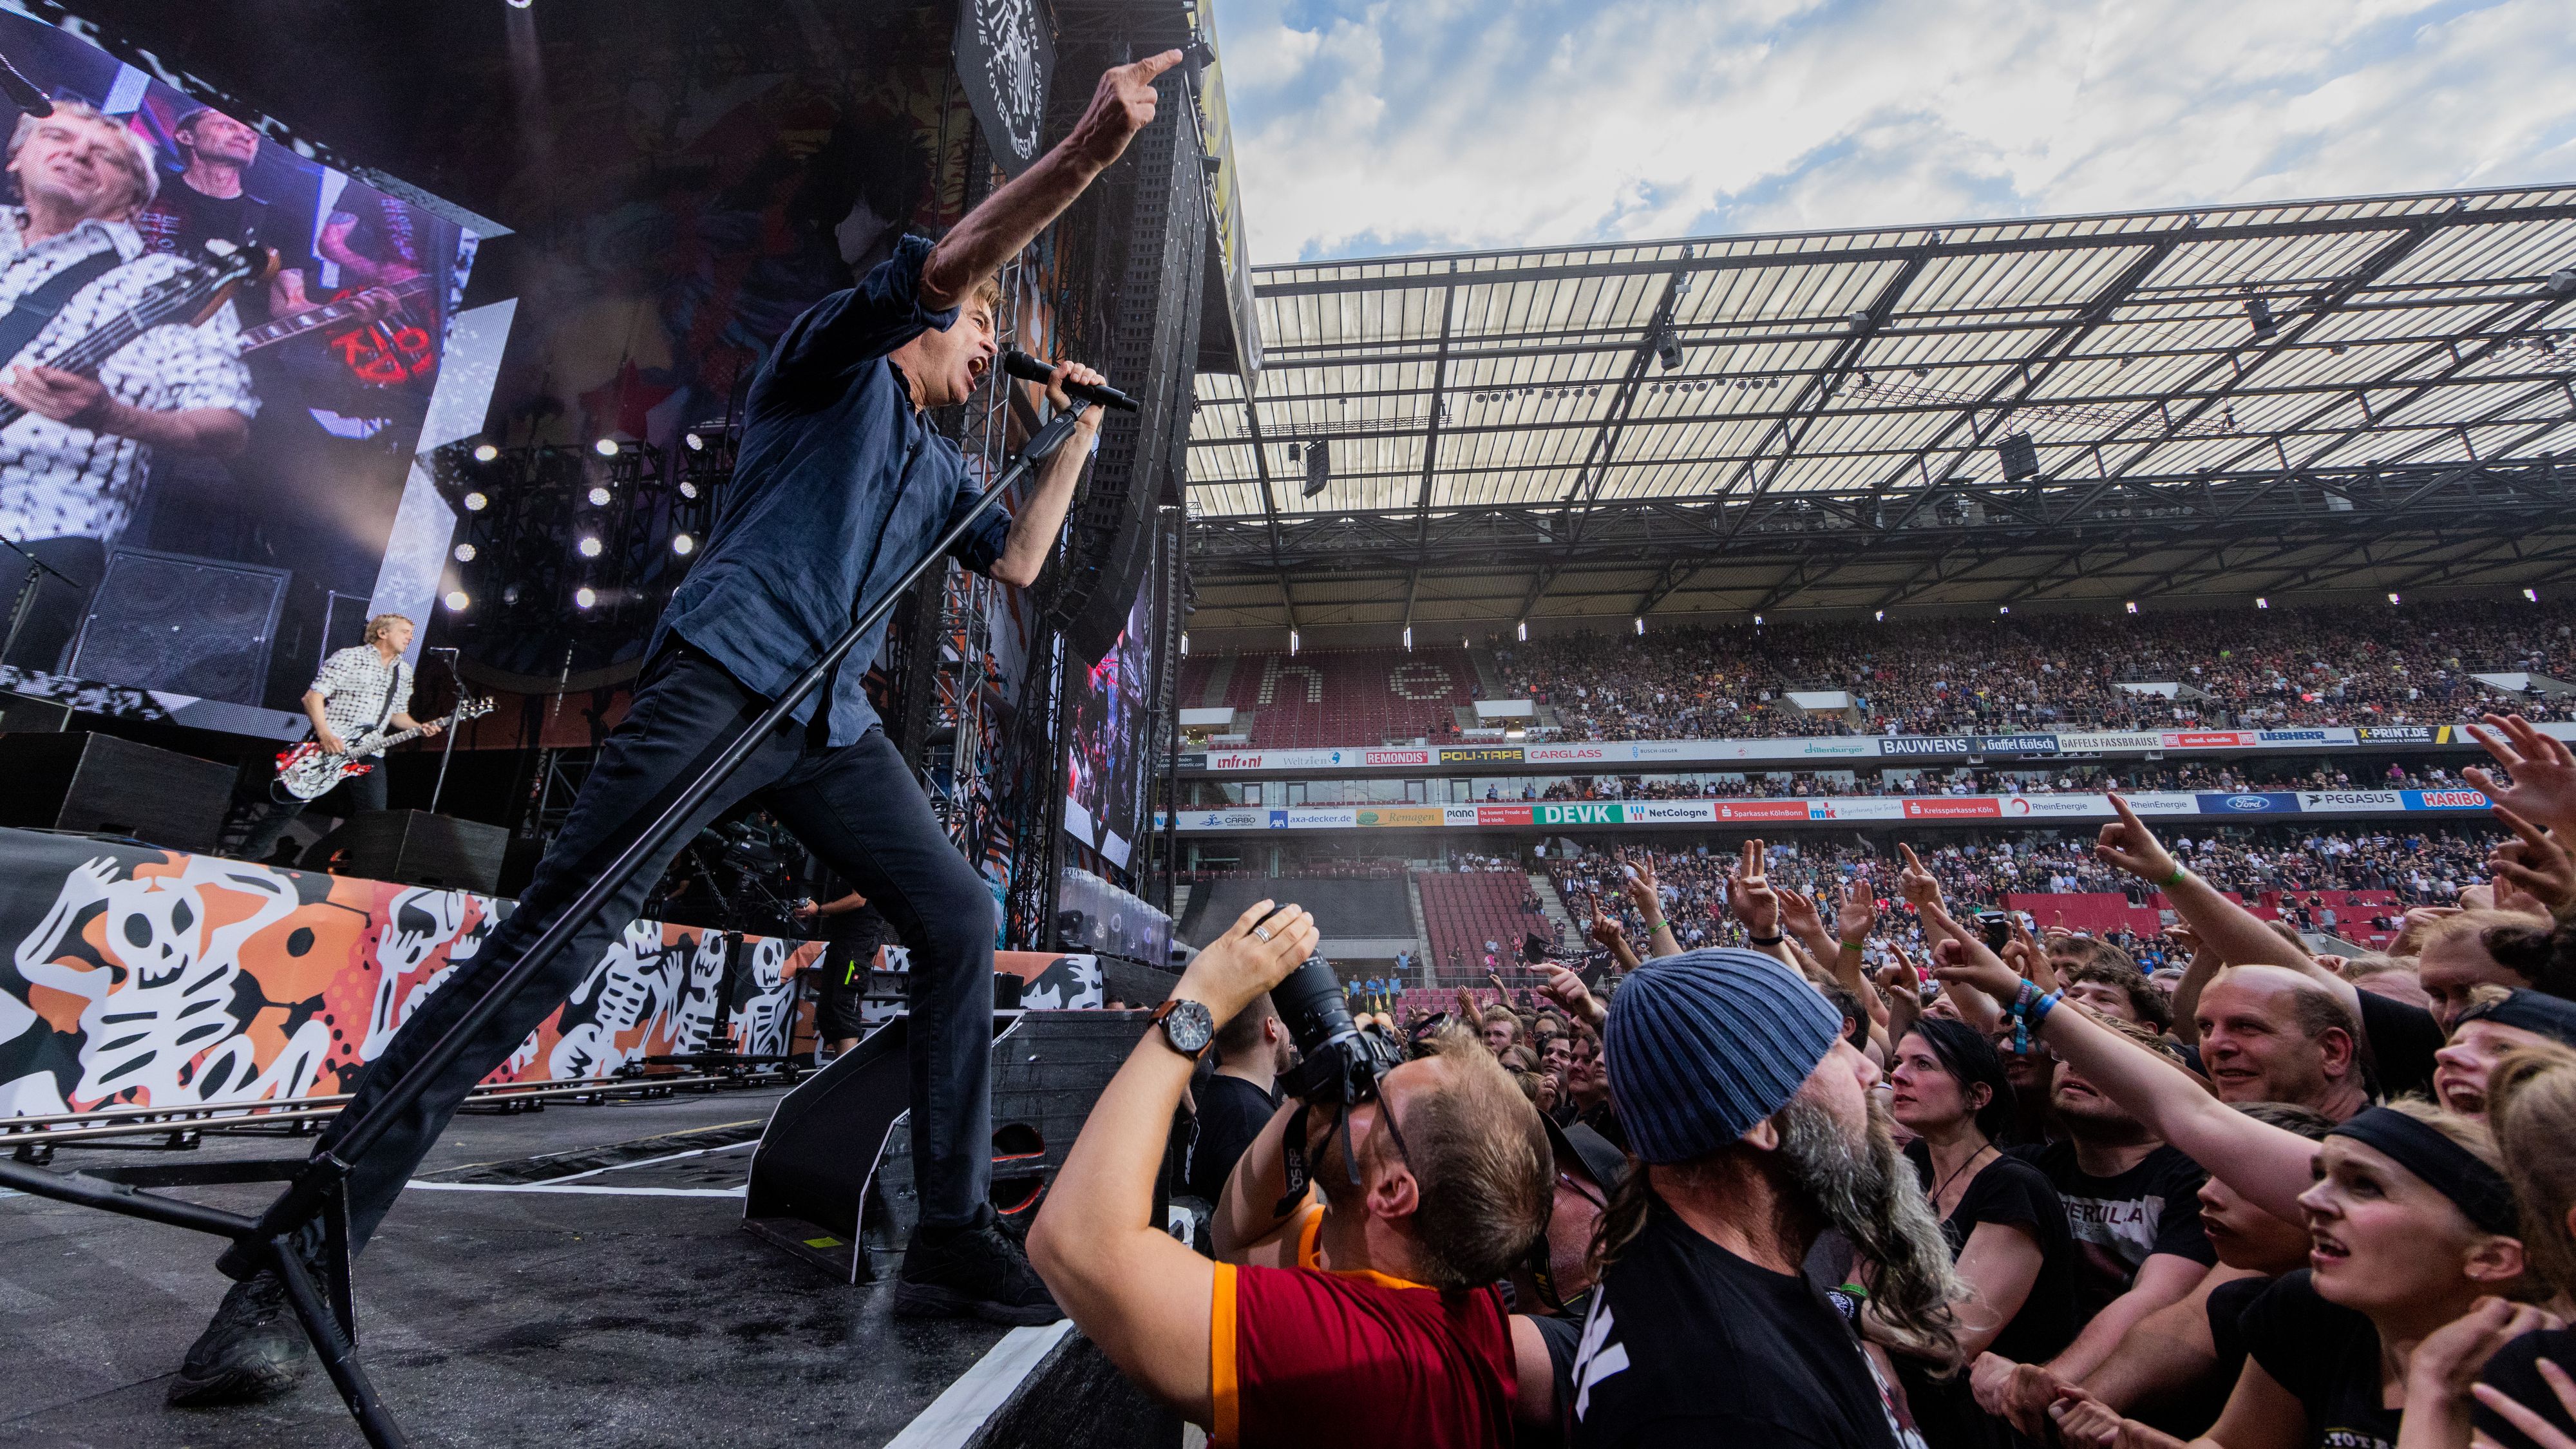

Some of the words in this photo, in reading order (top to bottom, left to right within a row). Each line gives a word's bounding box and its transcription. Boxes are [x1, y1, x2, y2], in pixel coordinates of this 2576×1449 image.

[2259, 731, 2326, 741] LIEBHERR
[2358, 727, 2429, 738] X-PRINT.DE
[1884, 739, 1967, 753] BAUWENS
[1987, 739, 2019, 750] Gaffel
[2020, 737, 2054, 750] Kölsch
[2061, 739, 2098, 748] GAFFELS
[2101, 737, 2159, 747] FASSBRAUSE
[1530, 749, 1602, 759] CARGLASS
[1804, 743, 1864, 754] dillenburger
[1283, 756, 1327, 766] Weltzien
[1441, 750, 1522, 761] POLI-TAPE
[2235, 798, 2262, 808] Ford
[2325, 793, 2395, 804] PEGASUS
[2423, 792, 2486, 807] HARIBO
[2032, 802, 2088, 811] RheinEnergie
[2131, 801, 2187, 810] RheinEnergie
[1389, 813, 1435, 824] Remagen
[1546, 806, 1611, 823] DEVK
[1649, 809, 1708, 819] NetCologne
[1269, 819, 1285, 828] AXA
